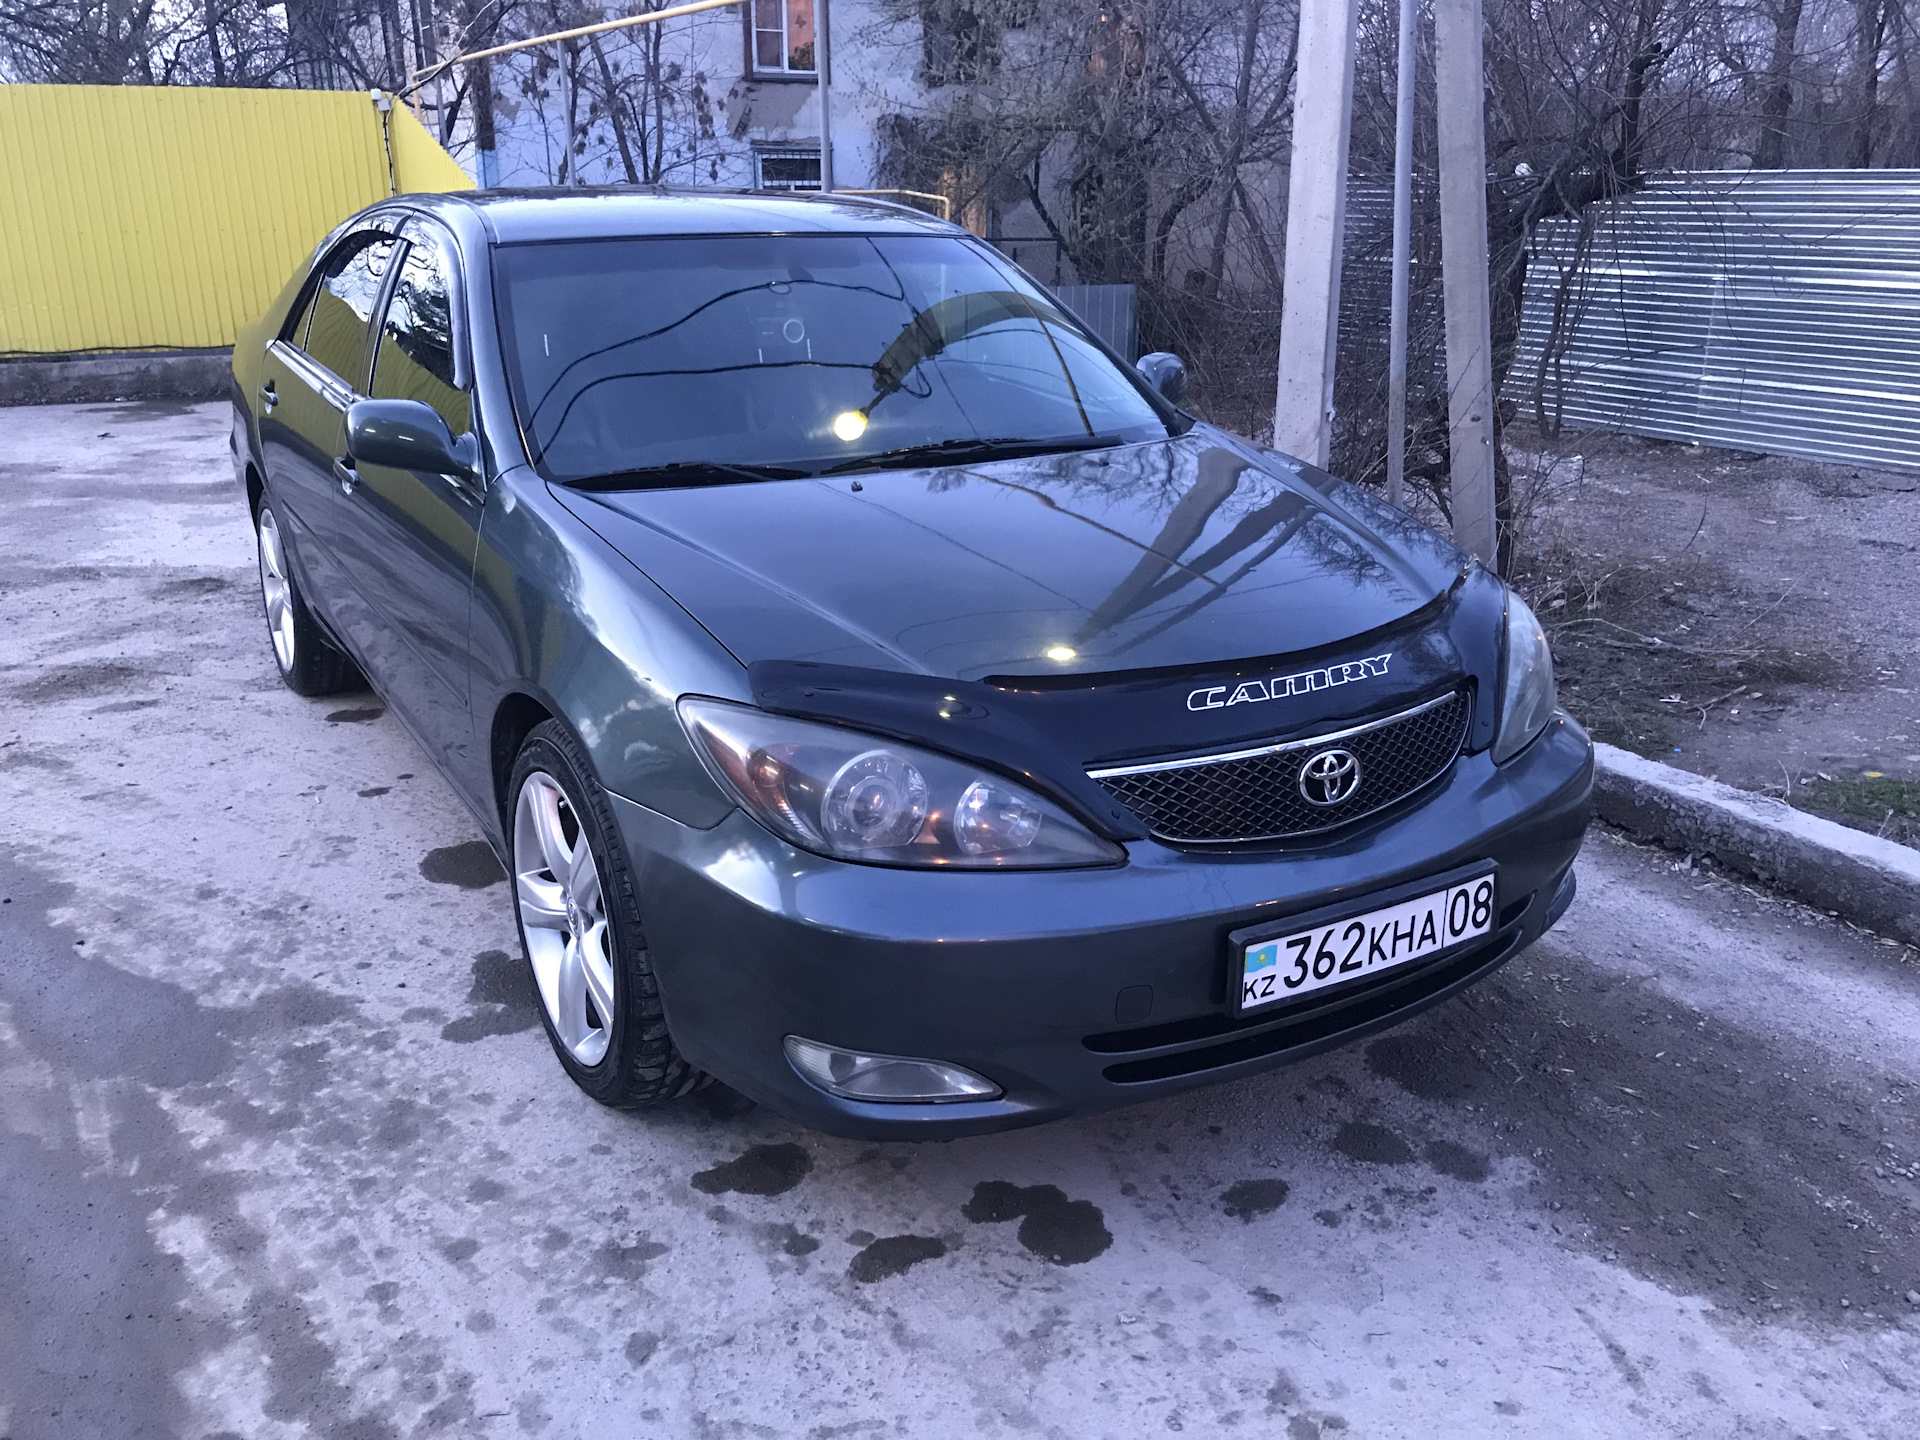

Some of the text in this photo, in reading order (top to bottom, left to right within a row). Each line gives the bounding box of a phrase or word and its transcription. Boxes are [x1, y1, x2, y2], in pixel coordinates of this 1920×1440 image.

[1187, 653, 1392, 711] CAMRY
[1283, 880, 1493, 988] 362KHA 08
[1243, 973, 1277, 1002] KZ
